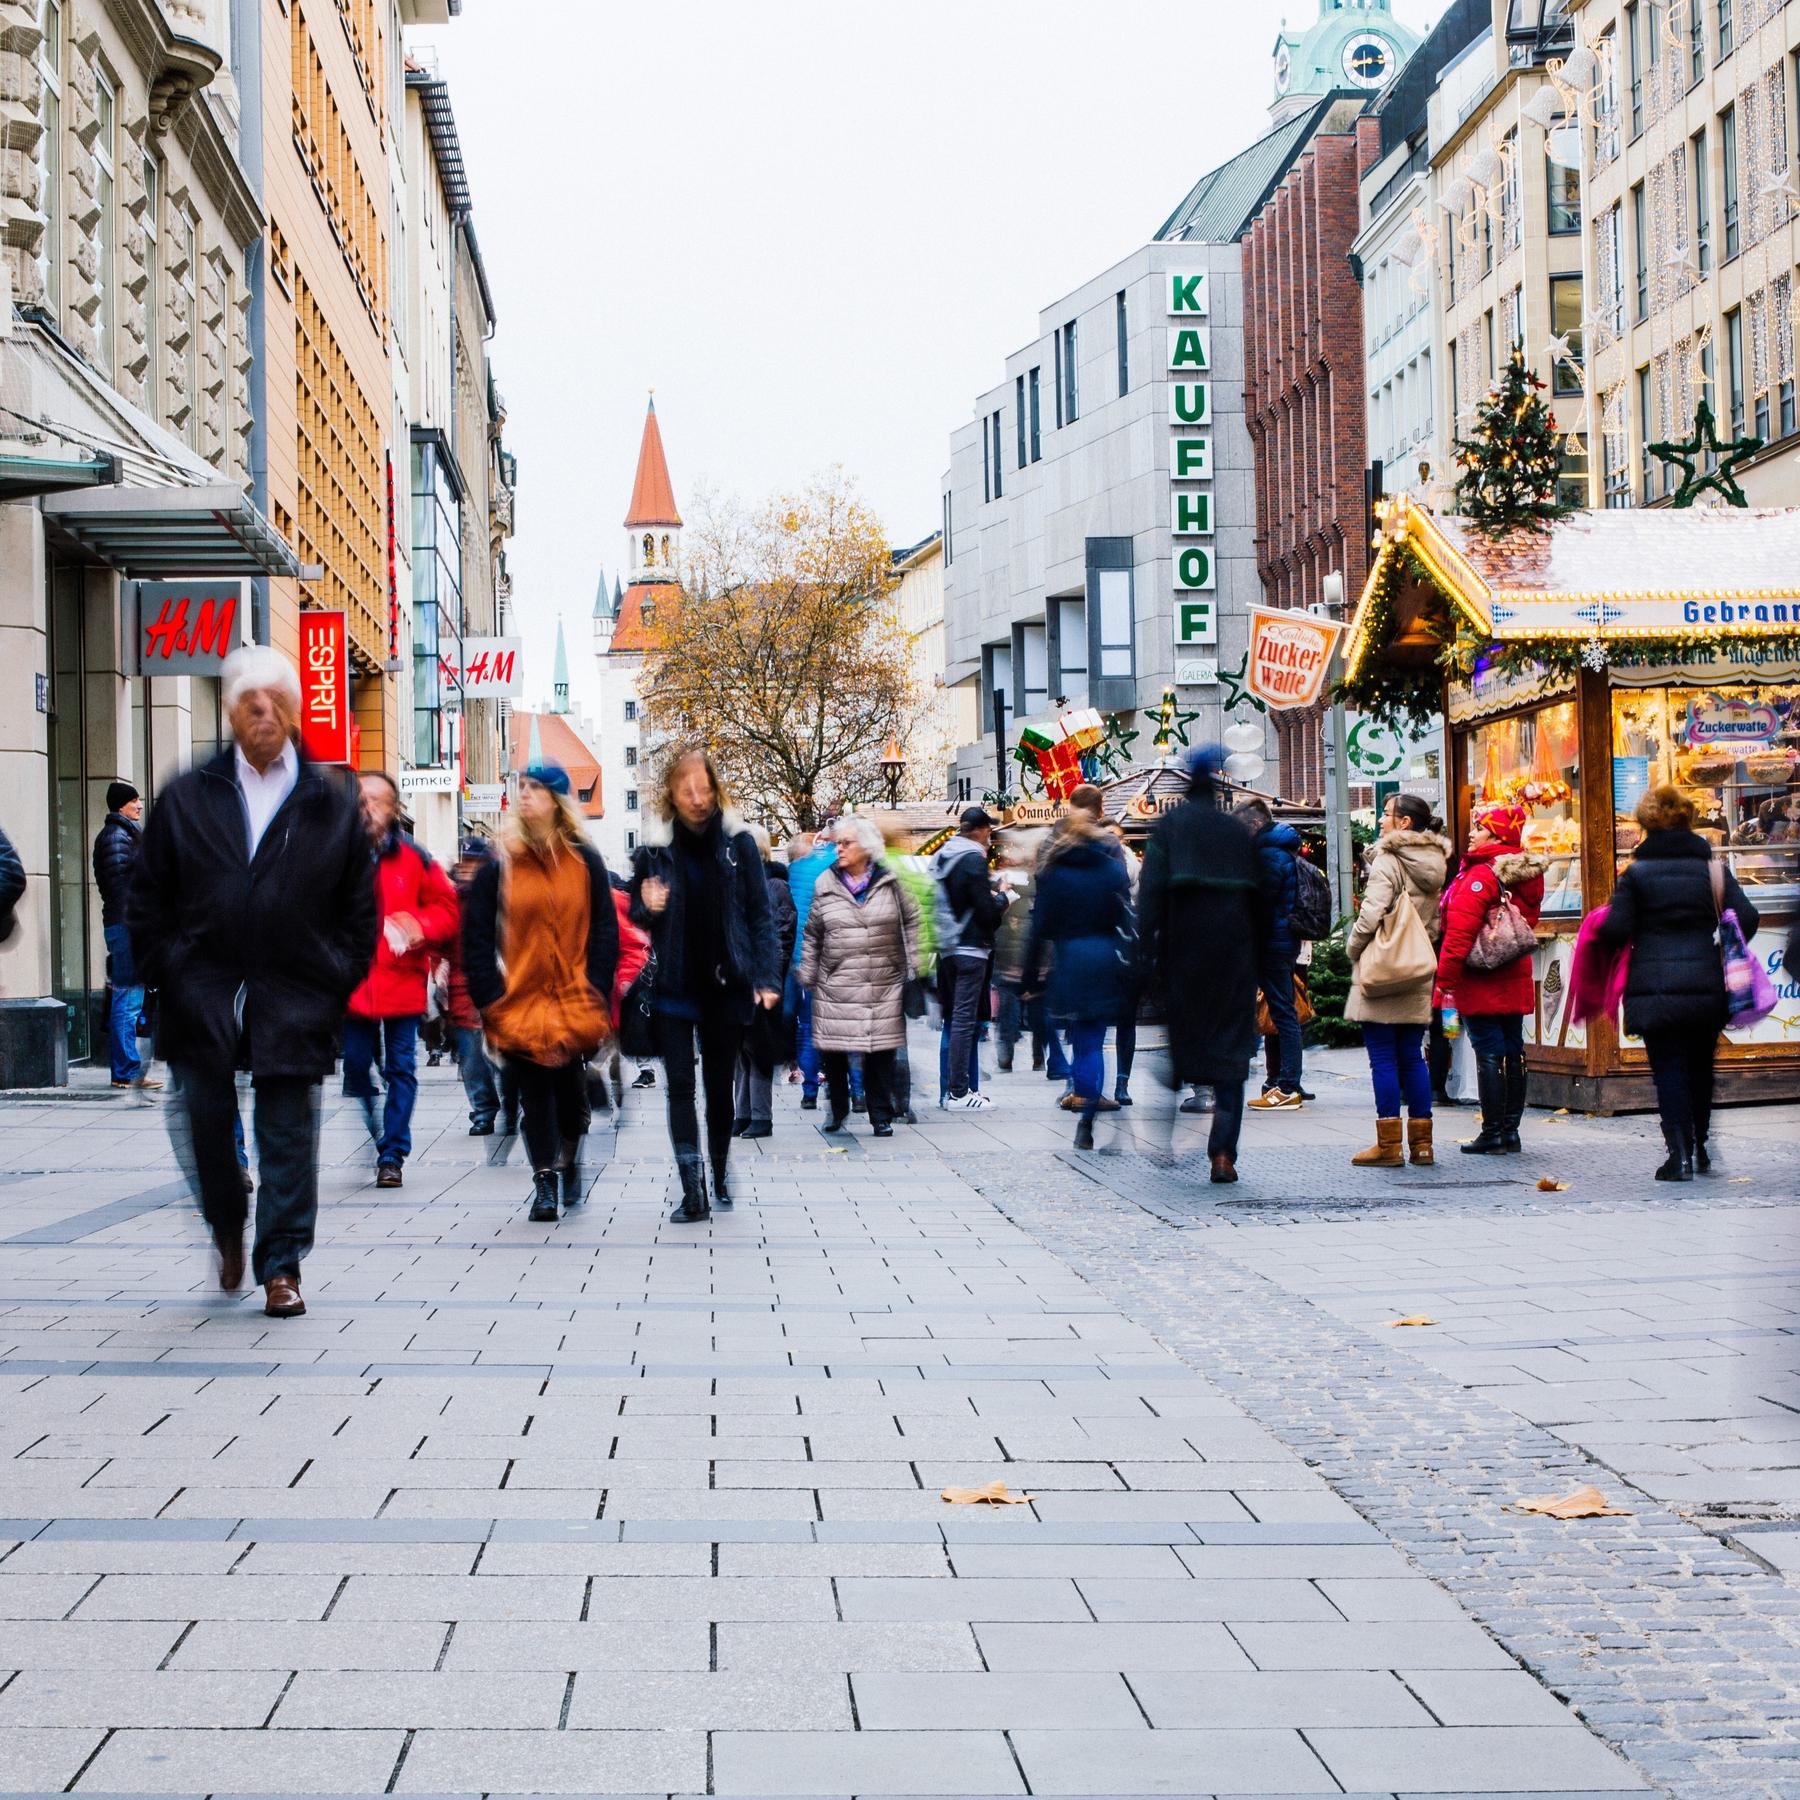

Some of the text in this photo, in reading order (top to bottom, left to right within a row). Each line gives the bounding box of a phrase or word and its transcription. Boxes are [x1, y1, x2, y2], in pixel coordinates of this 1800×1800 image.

[1172, 275, 1209, 641] KAUFHOF
[145, 597, 237, 660] H&M
[465, 650, 516, 685] H&M
[1257, 635, 1322, 671] Zucker-
[308, 627, 336, 730] ESPRIT
[1182, 670, 1213, 681] GALERIA
[1261, 665, 1306, 695] watte
[1697, 721, 1768, 733] Zuckerwatte
[401, 775, 452, 789] pimkie
